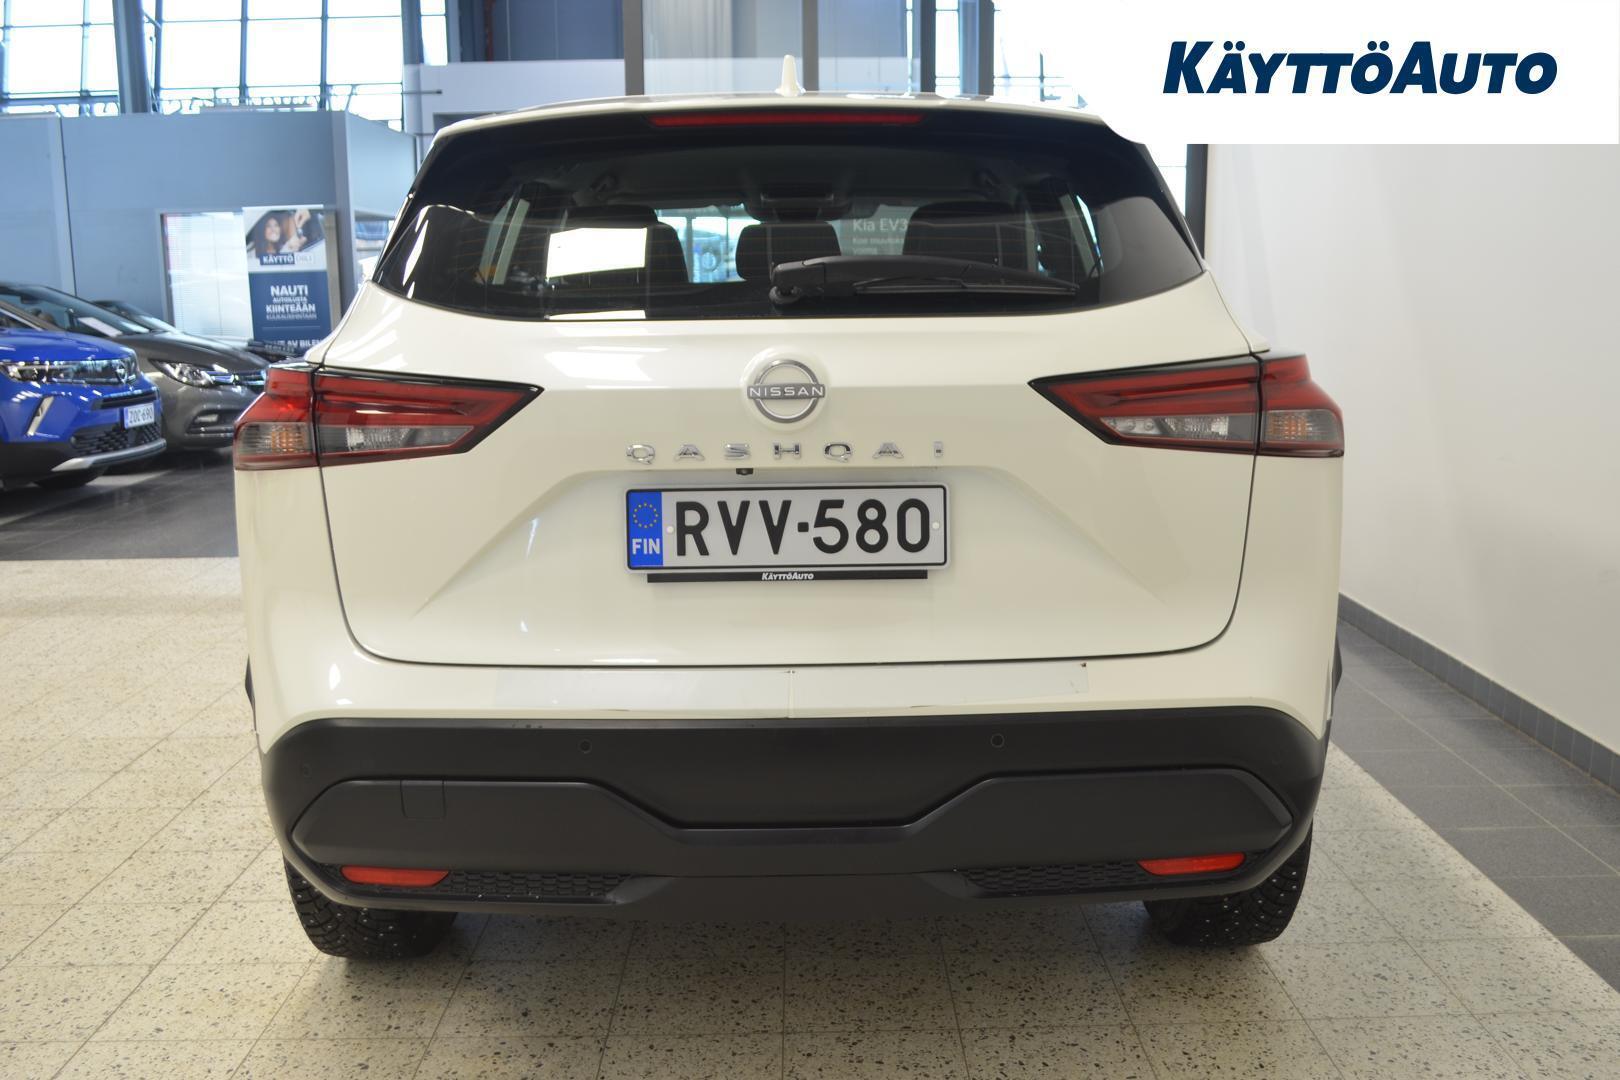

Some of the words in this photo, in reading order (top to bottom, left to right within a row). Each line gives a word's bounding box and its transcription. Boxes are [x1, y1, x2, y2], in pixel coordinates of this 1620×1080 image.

[853, 218, 875, 231] Kia
[880, 217, 908, 231] EV3
[262, 253, 294, 264] KÄYTTÖ
[270, 285, 308, 296] NAUTI
[265, 303, 316, 314] KIINTEÄÄN
[750, 385, 824, 397] NISSAN
[626, 441, 944, 464] QASHQAI
[675, 498, 930, 556] RVV-580
[632, 538, 660, 555] FIN
